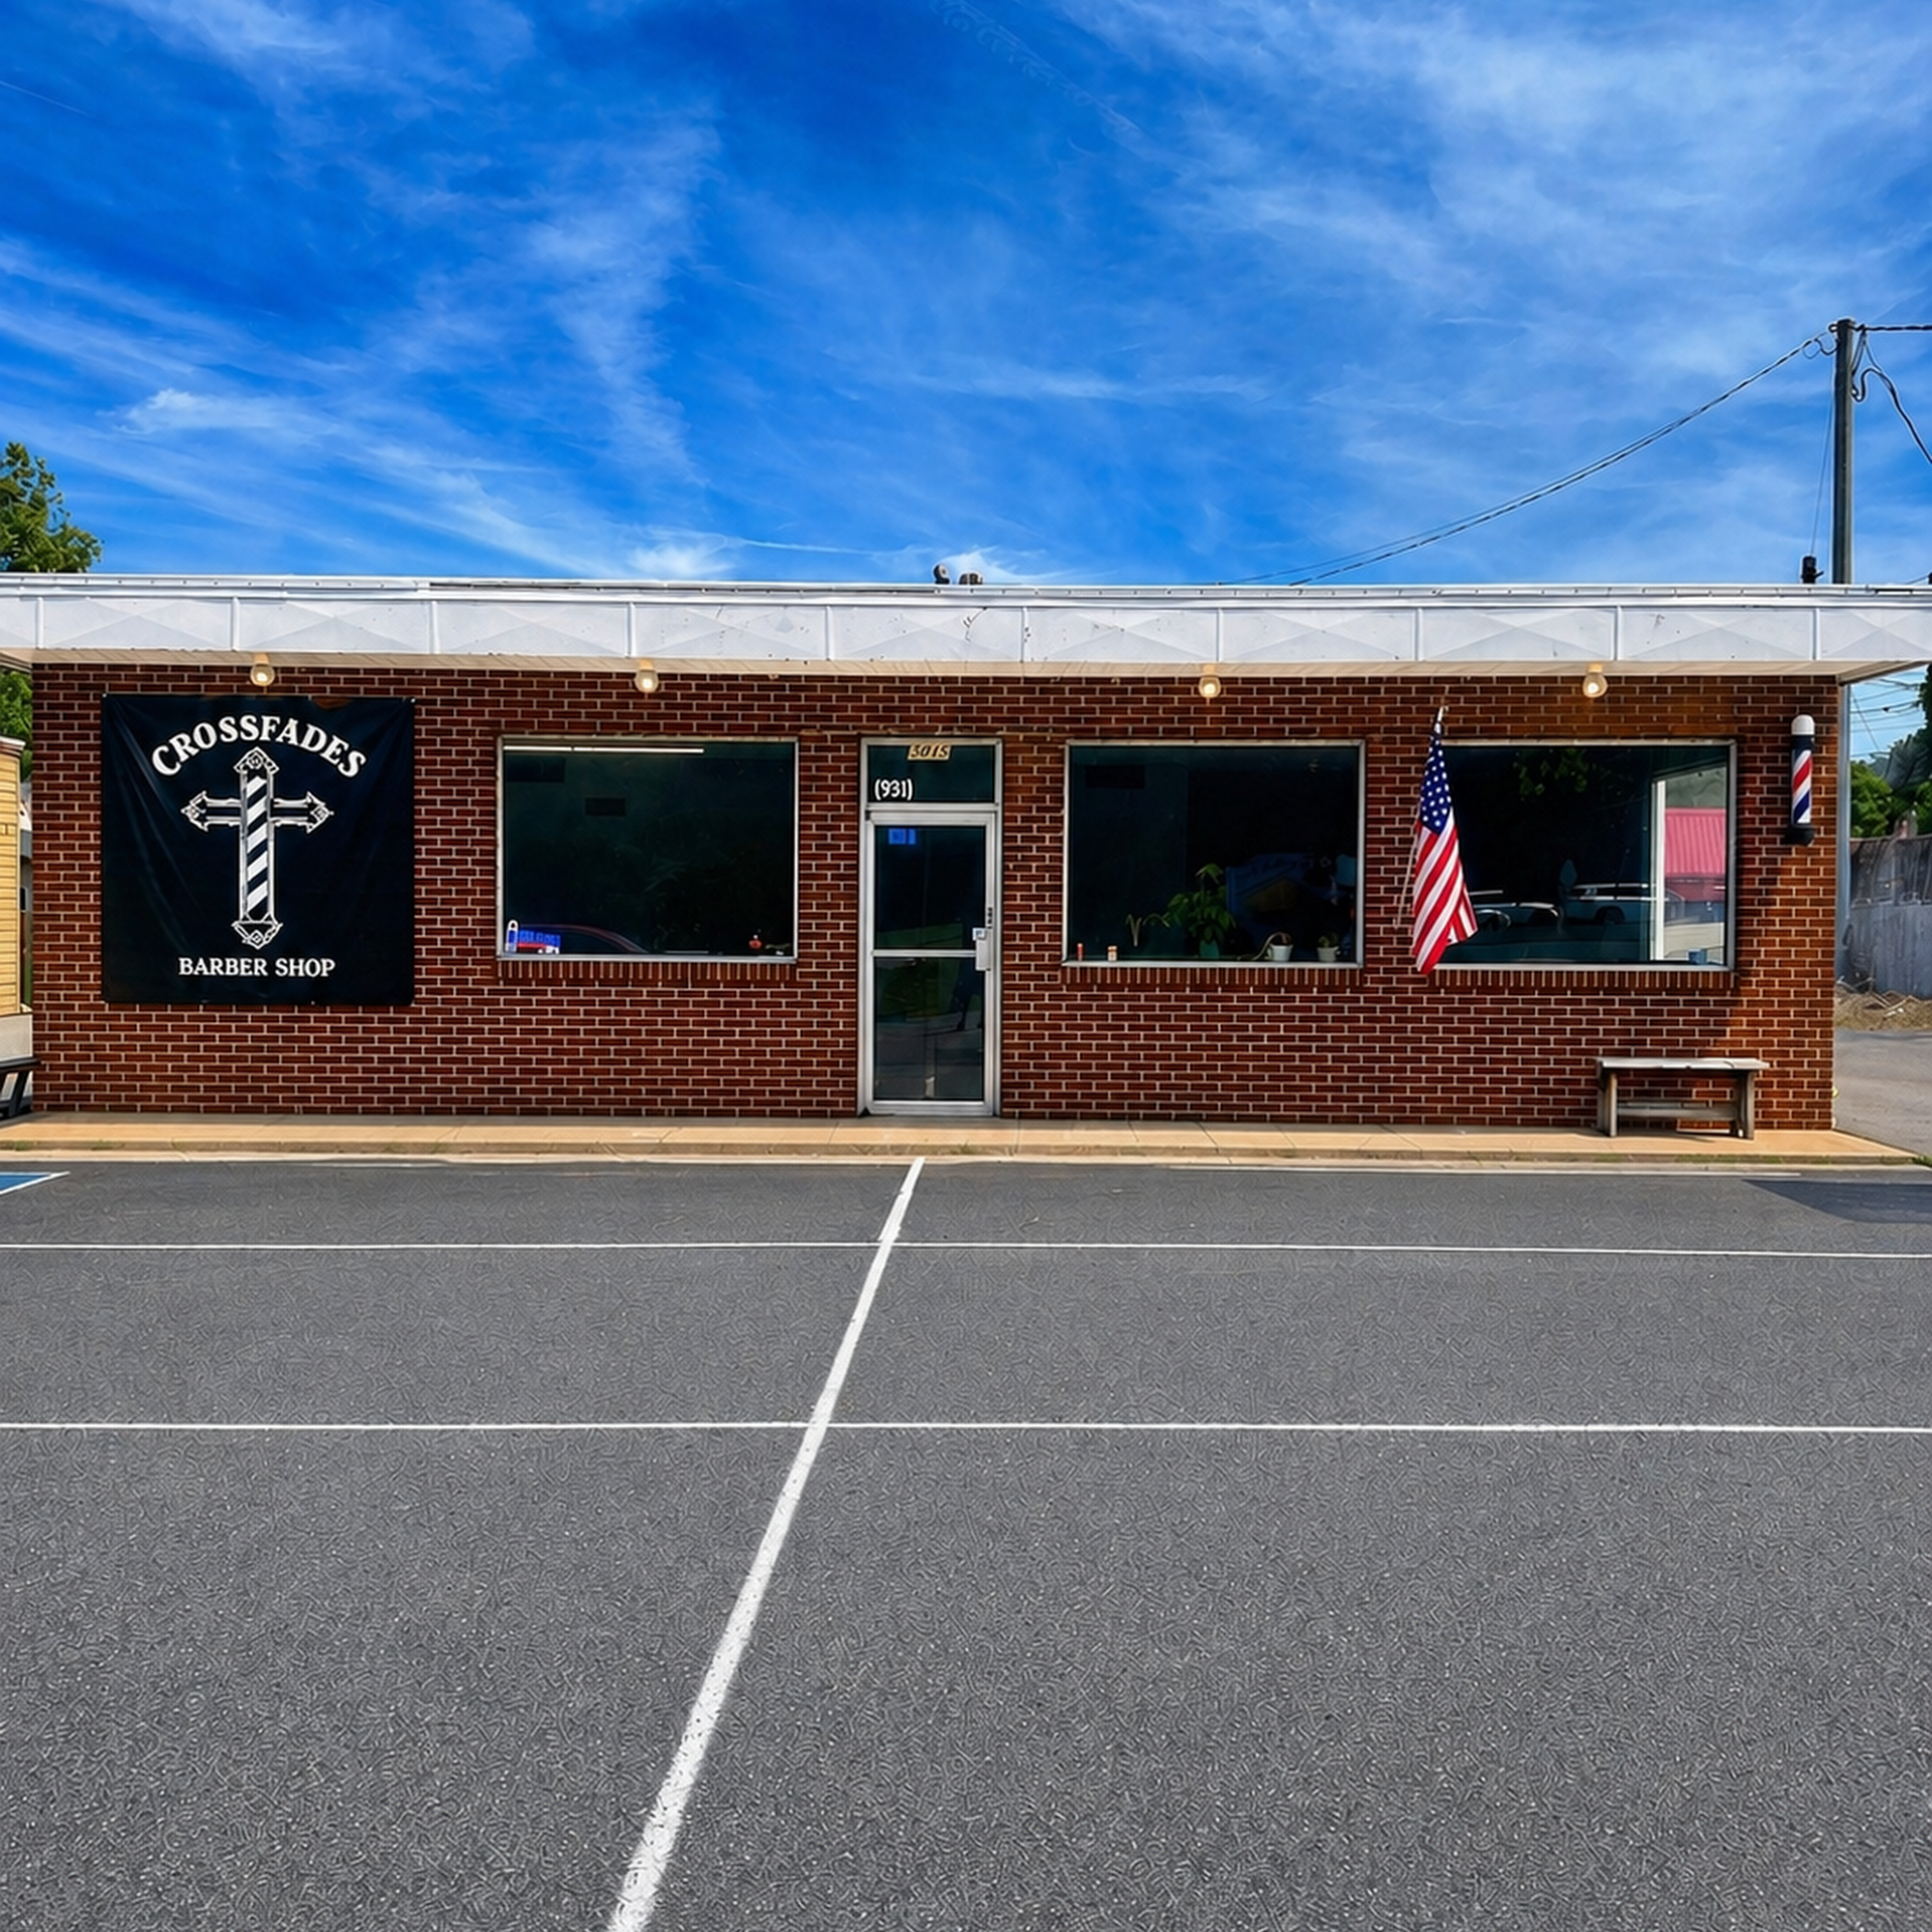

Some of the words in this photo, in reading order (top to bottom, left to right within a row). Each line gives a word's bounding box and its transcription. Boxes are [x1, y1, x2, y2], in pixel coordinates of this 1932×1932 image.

[152, 715, 366, 778] CROSSFADES
[874, 779, 913, 801] (931)
[178, 957, 269, 977] BARBER
[274, 957, 336, 978] SHOP
